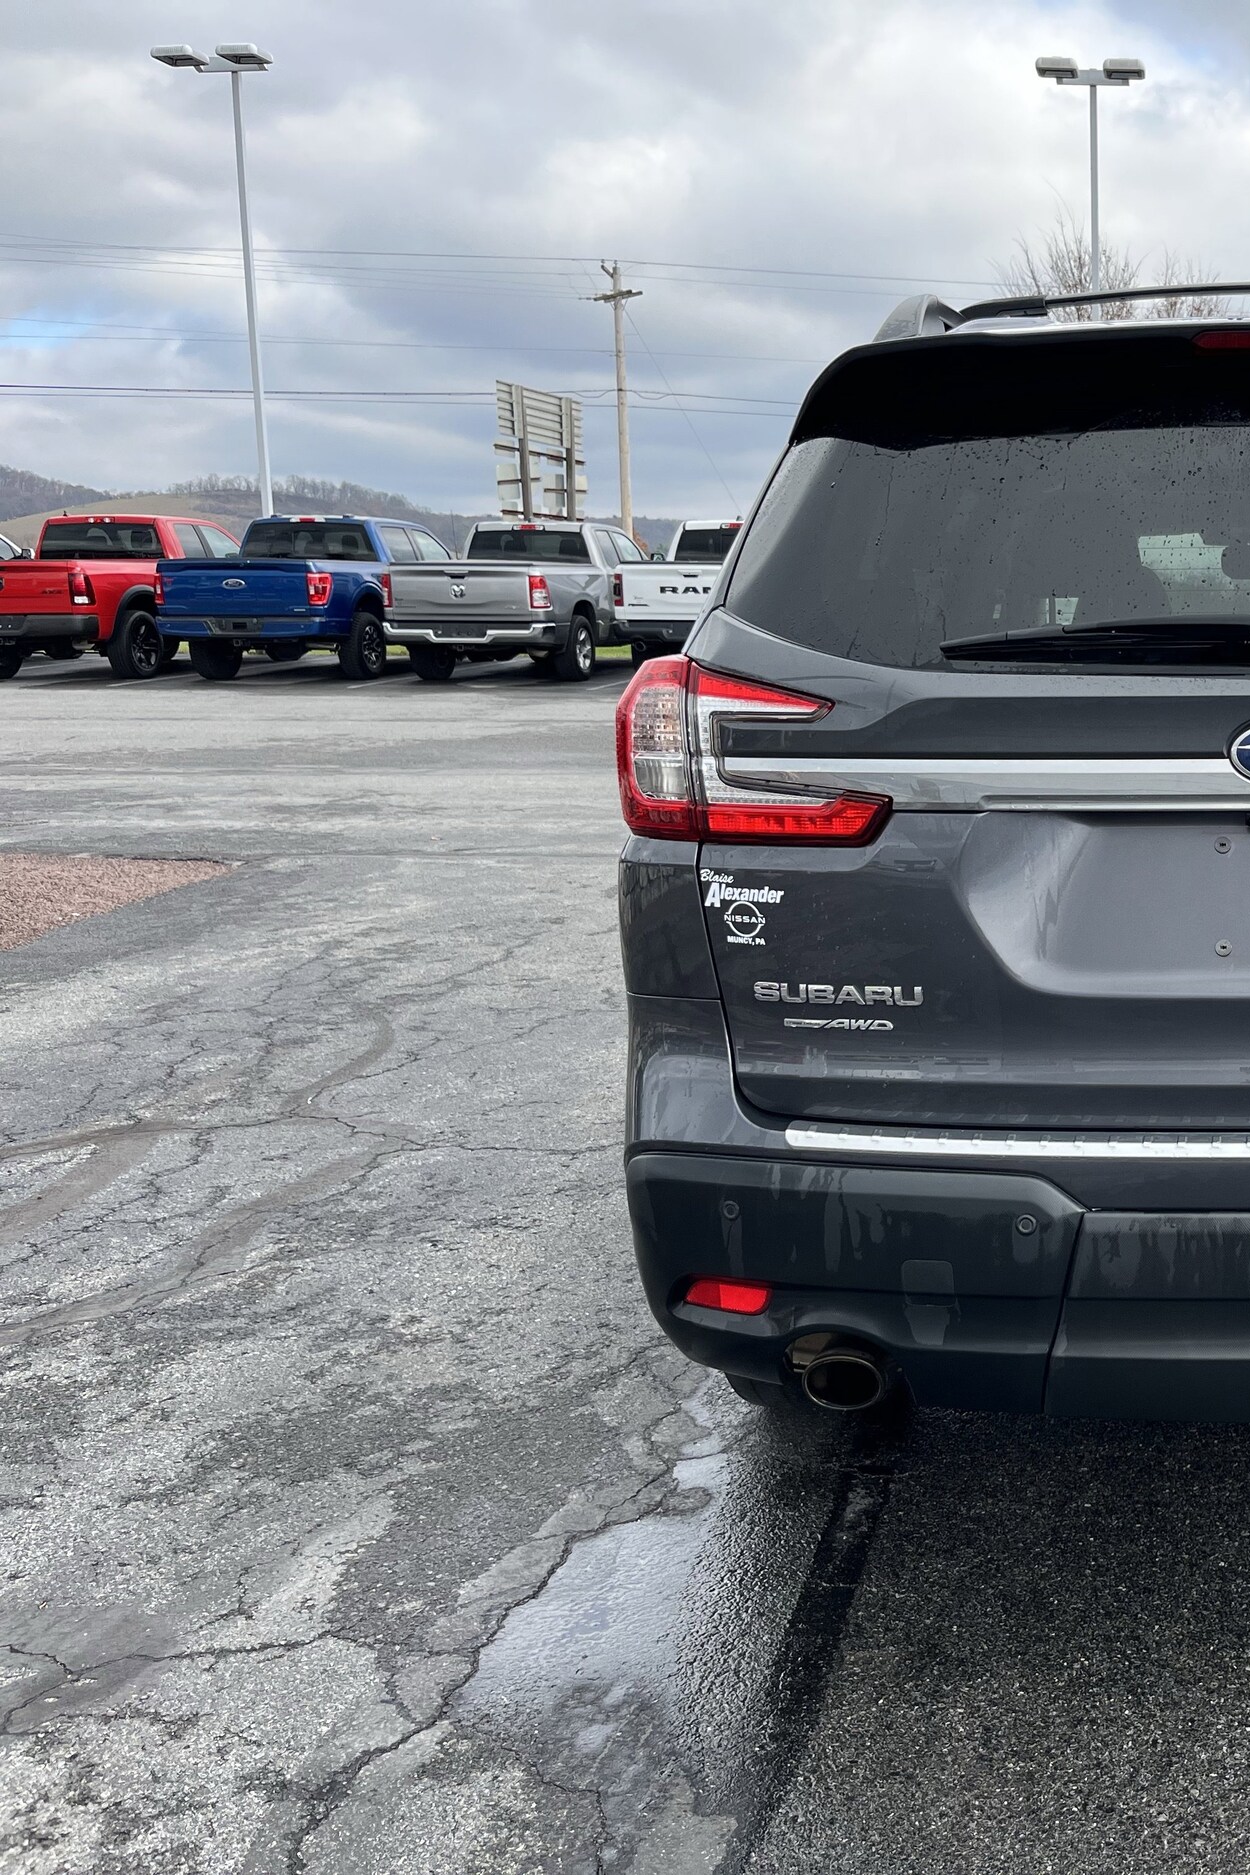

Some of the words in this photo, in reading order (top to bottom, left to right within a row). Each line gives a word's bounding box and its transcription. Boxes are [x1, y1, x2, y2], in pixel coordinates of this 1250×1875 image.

[700, 869, 734, 883] Blaise
[704, 882, 784, 908] Alexander
[724, 914, 766, 924] NISSAN
[727, 935, 755, 946] MUNCY,
[756, 937, 766, 945] PA
[753, 981, 923, 1006] SUBARU
[823, 1018, 894, 1031] AWD
